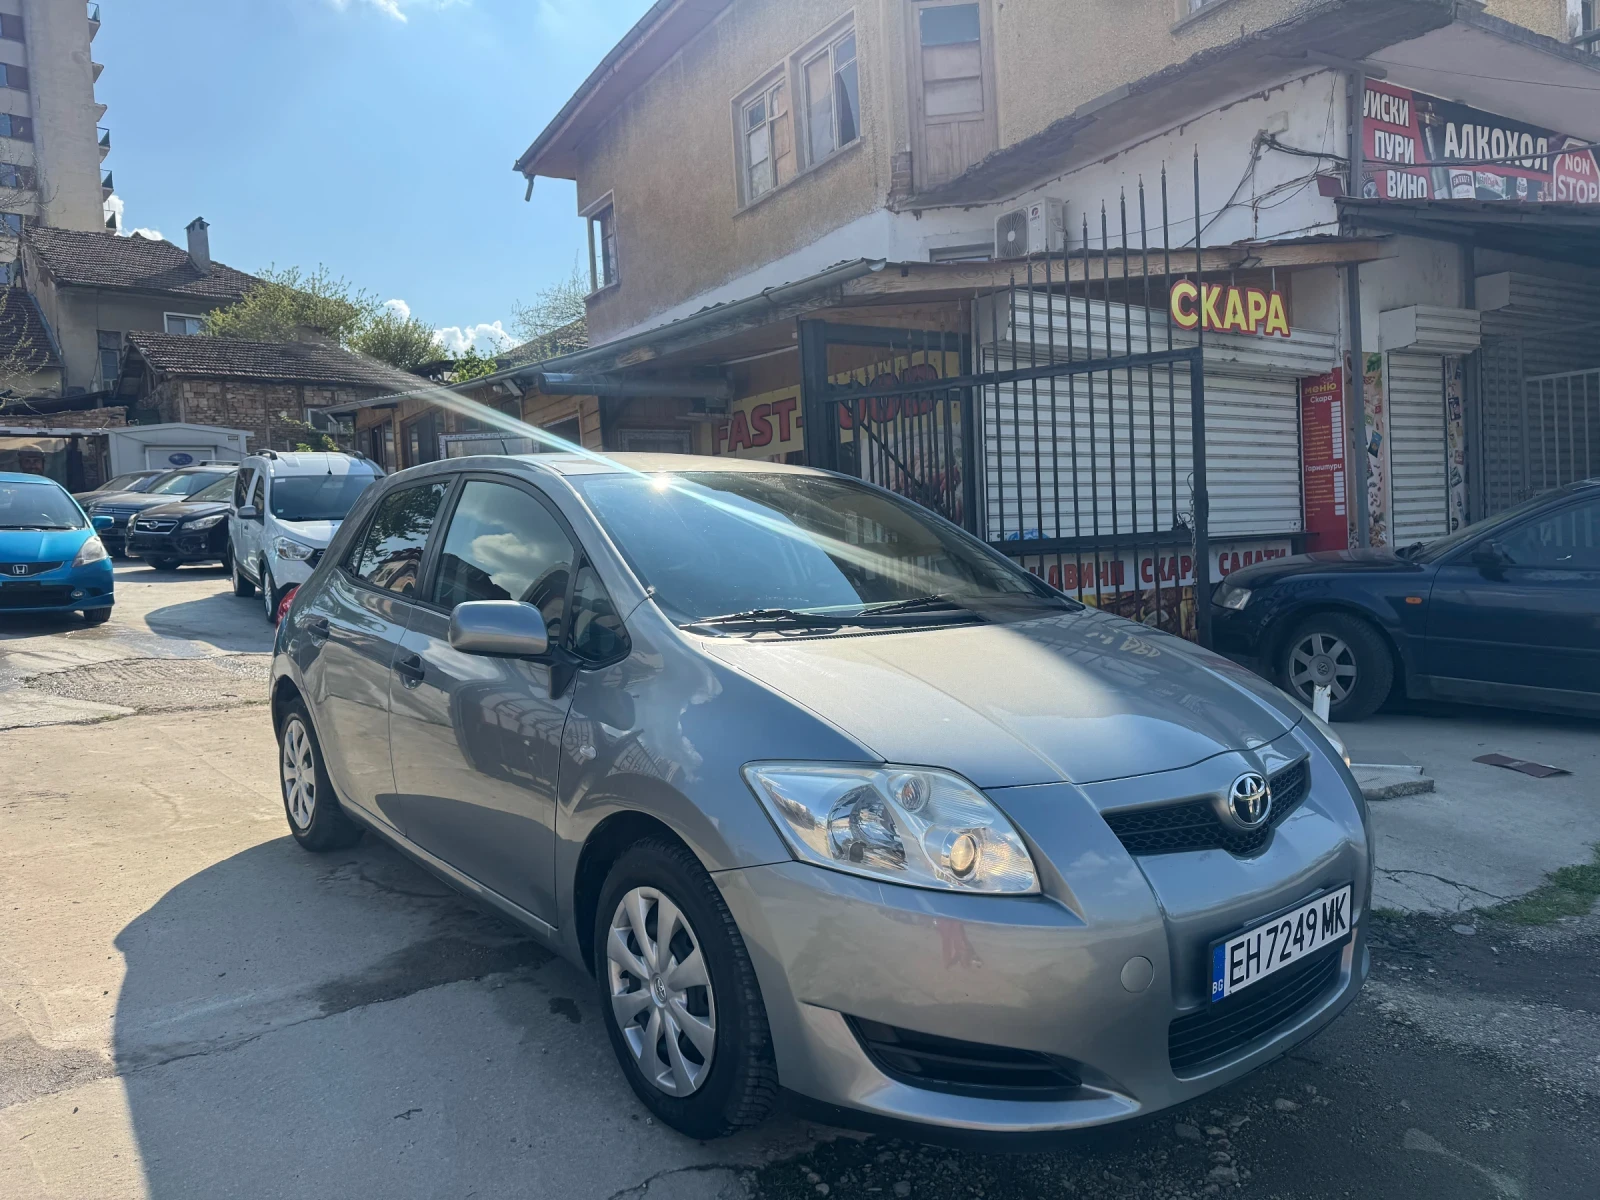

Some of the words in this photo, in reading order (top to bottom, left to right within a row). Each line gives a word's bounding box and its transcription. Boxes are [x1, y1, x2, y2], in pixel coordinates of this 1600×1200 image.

[1363, 89, 1409, 127] УИСКИ
[1374, 129, 1414, 165] ПУРИ
[1444, 122, 1548, 171] АЛКОХОЛ
[1565, 153, 1590, 176] NON
[1387, 169, 1427, 199] ВИНО
[1557, 174, 1598, 203] STOP
[1171, 282, 1289, 335] СКАРА
[1140, 555, 1193, 583] СКАР
[1212, 979, 1224, 994] BG
